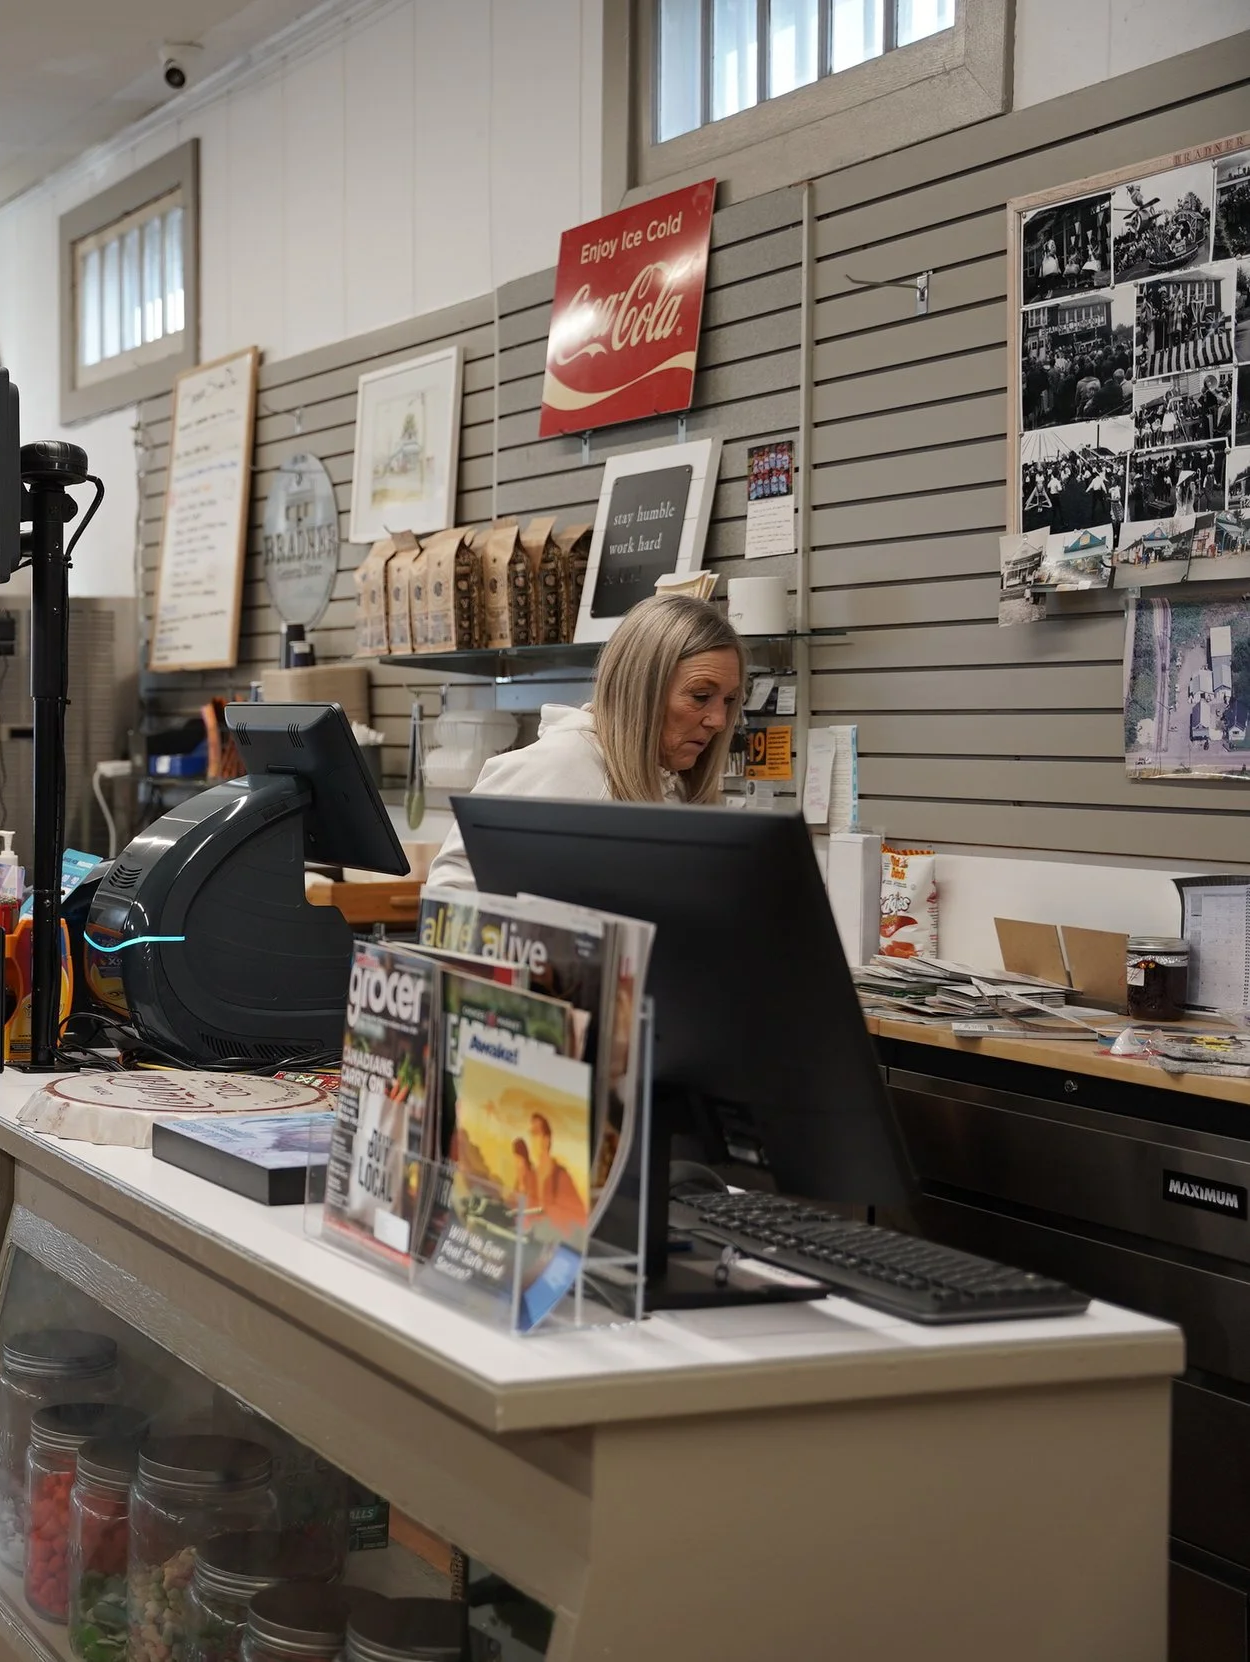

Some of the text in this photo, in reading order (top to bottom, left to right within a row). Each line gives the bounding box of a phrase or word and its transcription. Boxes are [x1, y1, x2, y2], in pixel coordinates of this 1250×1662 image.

[1173, 136, 1244, 165] BRADNER
[580, 211, 682, 265] Enjoy Ice Cold
[555, 260, 683, 366] Coca-Cola
[613, 500, 676, 527] stay humble
[264, 521, 337, 565] BRADNER
[609, 532, 662, 555] work hard
[482, 922, 548, 975] alive
[347, 963, 426, 1027] grocer
[343, 1045, 395, 1079] CANADIANS
[469, 1034, 518, 1066] Awake!
[341, 1063, 386, 1096] CARRY ON
[357, 1156, 392, 1203] LOCAL
[1169, 1179, 1238, 1209] MAXIMUM
[449, 1224, 468, 1243] Will
[434, 1255, 473, 1281] Secure?
[441, 1239, 505, 1279] Feel Safe and
[350, 1508, 374, 1520] ALLS
